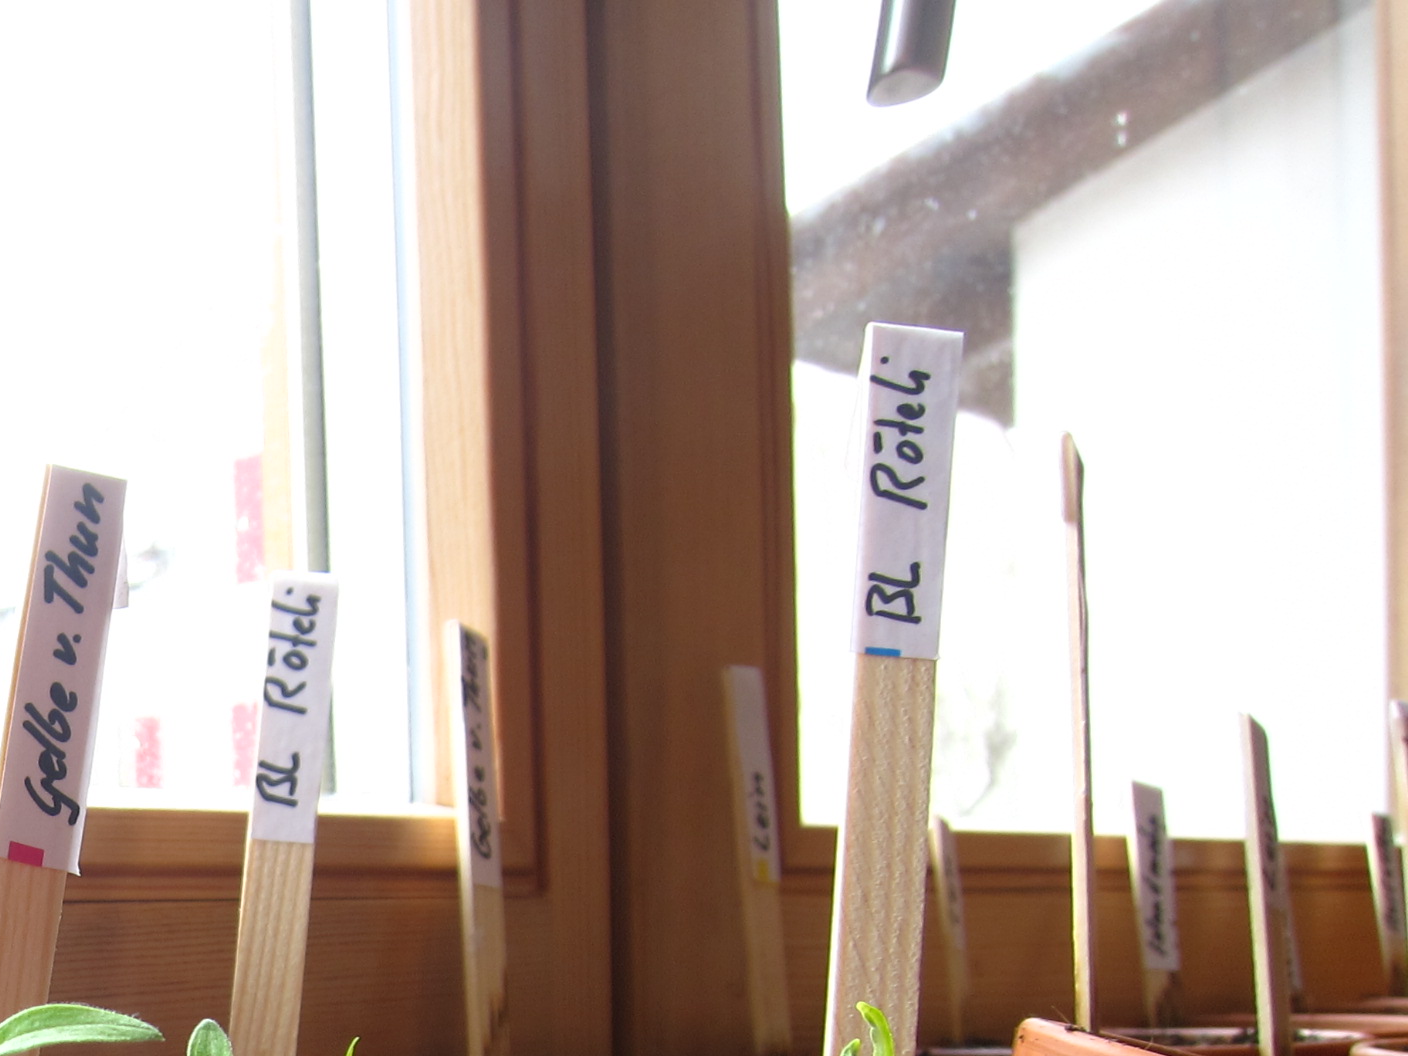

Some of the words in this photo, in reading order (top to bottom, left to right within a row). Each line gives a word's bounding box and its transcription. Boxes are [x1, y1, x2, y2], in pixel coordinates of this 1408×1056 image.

[43, 482, 106, 615] Thun
[865, 561, 922, 625] BL
[52, 631, 83, 667] v.
[22, 681, 80, 827] Gelbe
[255, 751, 301, 808] BL
